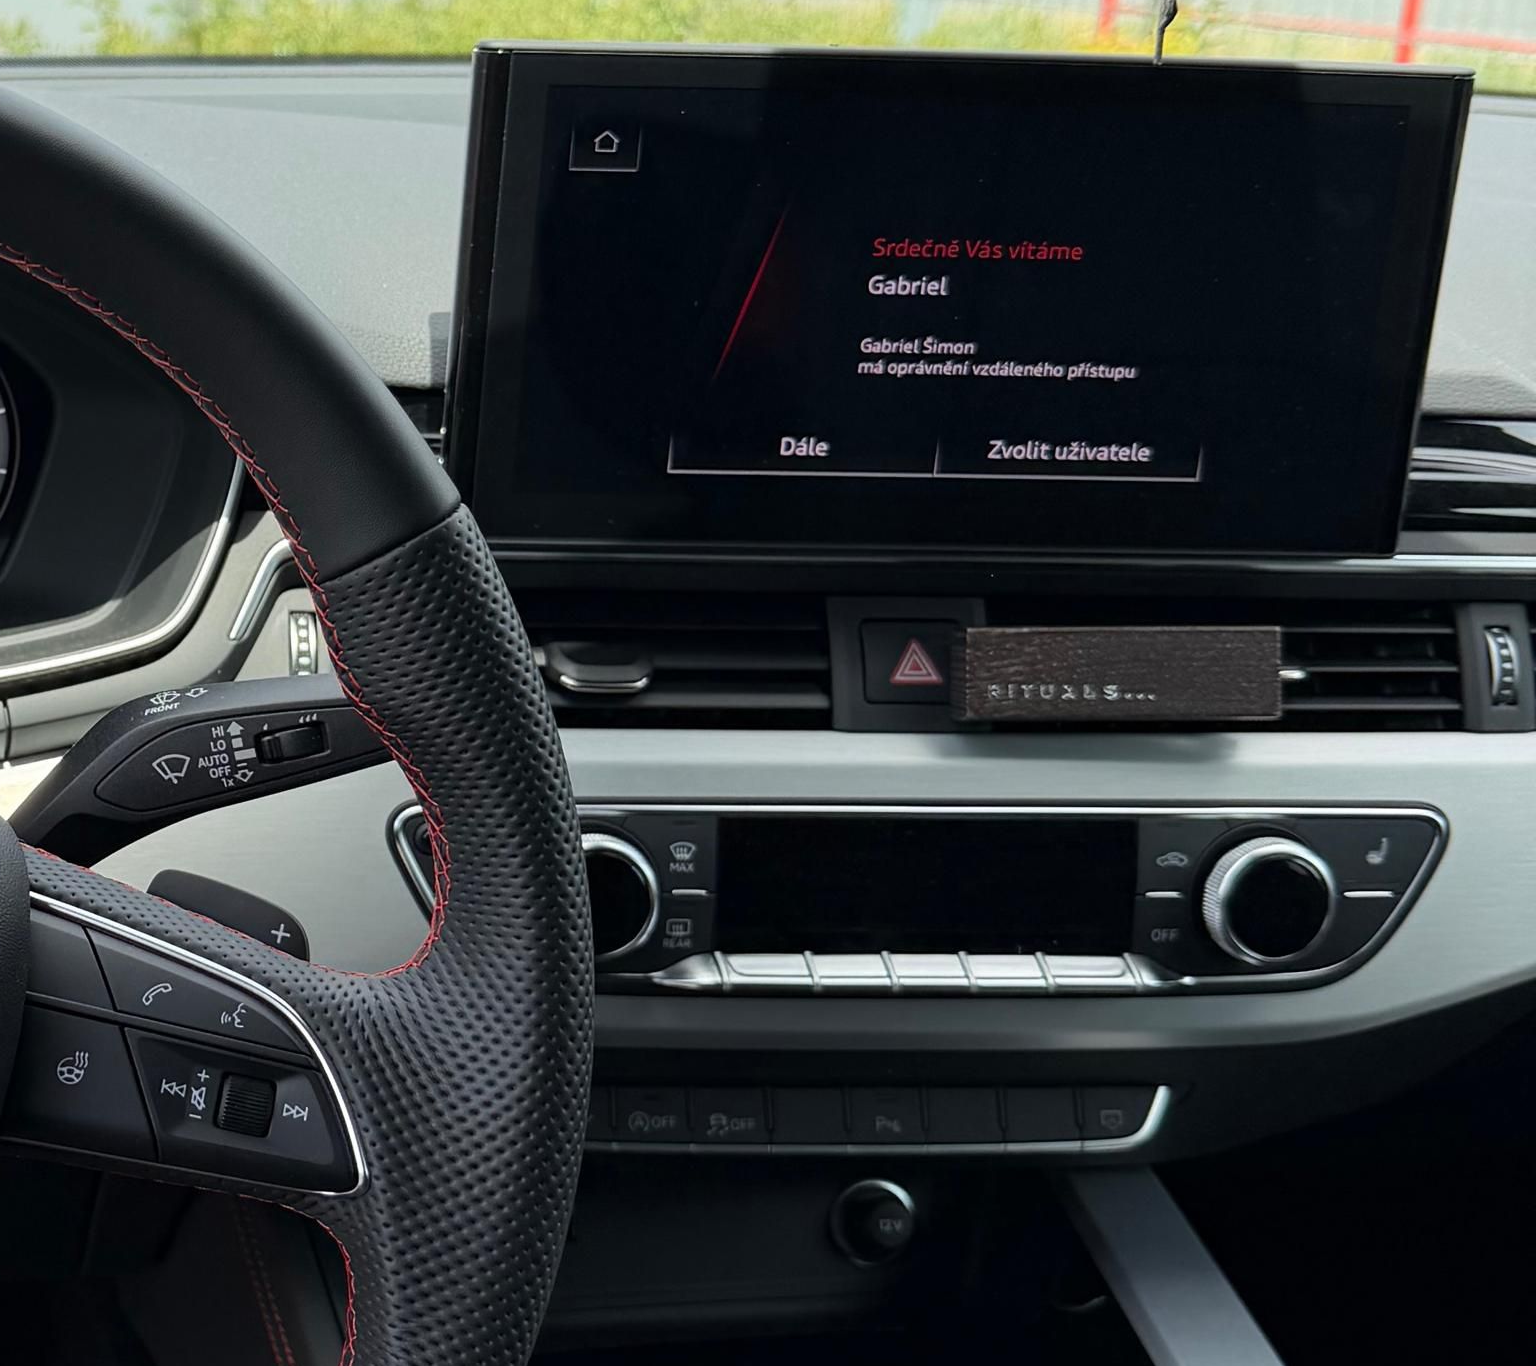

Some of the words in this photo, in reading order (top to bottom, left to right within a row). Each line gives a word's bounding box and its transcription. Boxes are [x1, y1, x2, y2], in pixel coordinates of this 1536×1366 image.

[872, 238, 960, 258] Srdečně
[966, 239, 1003, 259] Vás
[1008, 241, 1084, 260] vítáme
[868, 275, 948, 296] Gabriel
[860, 337, 920, 354] Gabriel
[922, 336, 976, 355] Šimon
[858, 360, 883, 375] má
[887, 361, 969, 378] oprávnění
[972, 361, 1064, 377] vzdáleného
[1066, 363, 1137, 381] přístupu
[779, 437, 830, 457] Dále
[987, 440, 1051, 460] Zvolit
[1054, 440, 1151, 462] uživatele
[144, 702, 180, 717] FRONT
[211, 725, 224, 739] HI
[210, 739, 227, 753] LO
[198, 753, 230, 770] AUTO
[209, 765, 232, 780] OFF
[221, 777, 235, 788] 1x
[669, 862, 694, 872] MAX
[1151, 928, 1179, 941] OFF
[651, 1115, 678, 1129] OFF
